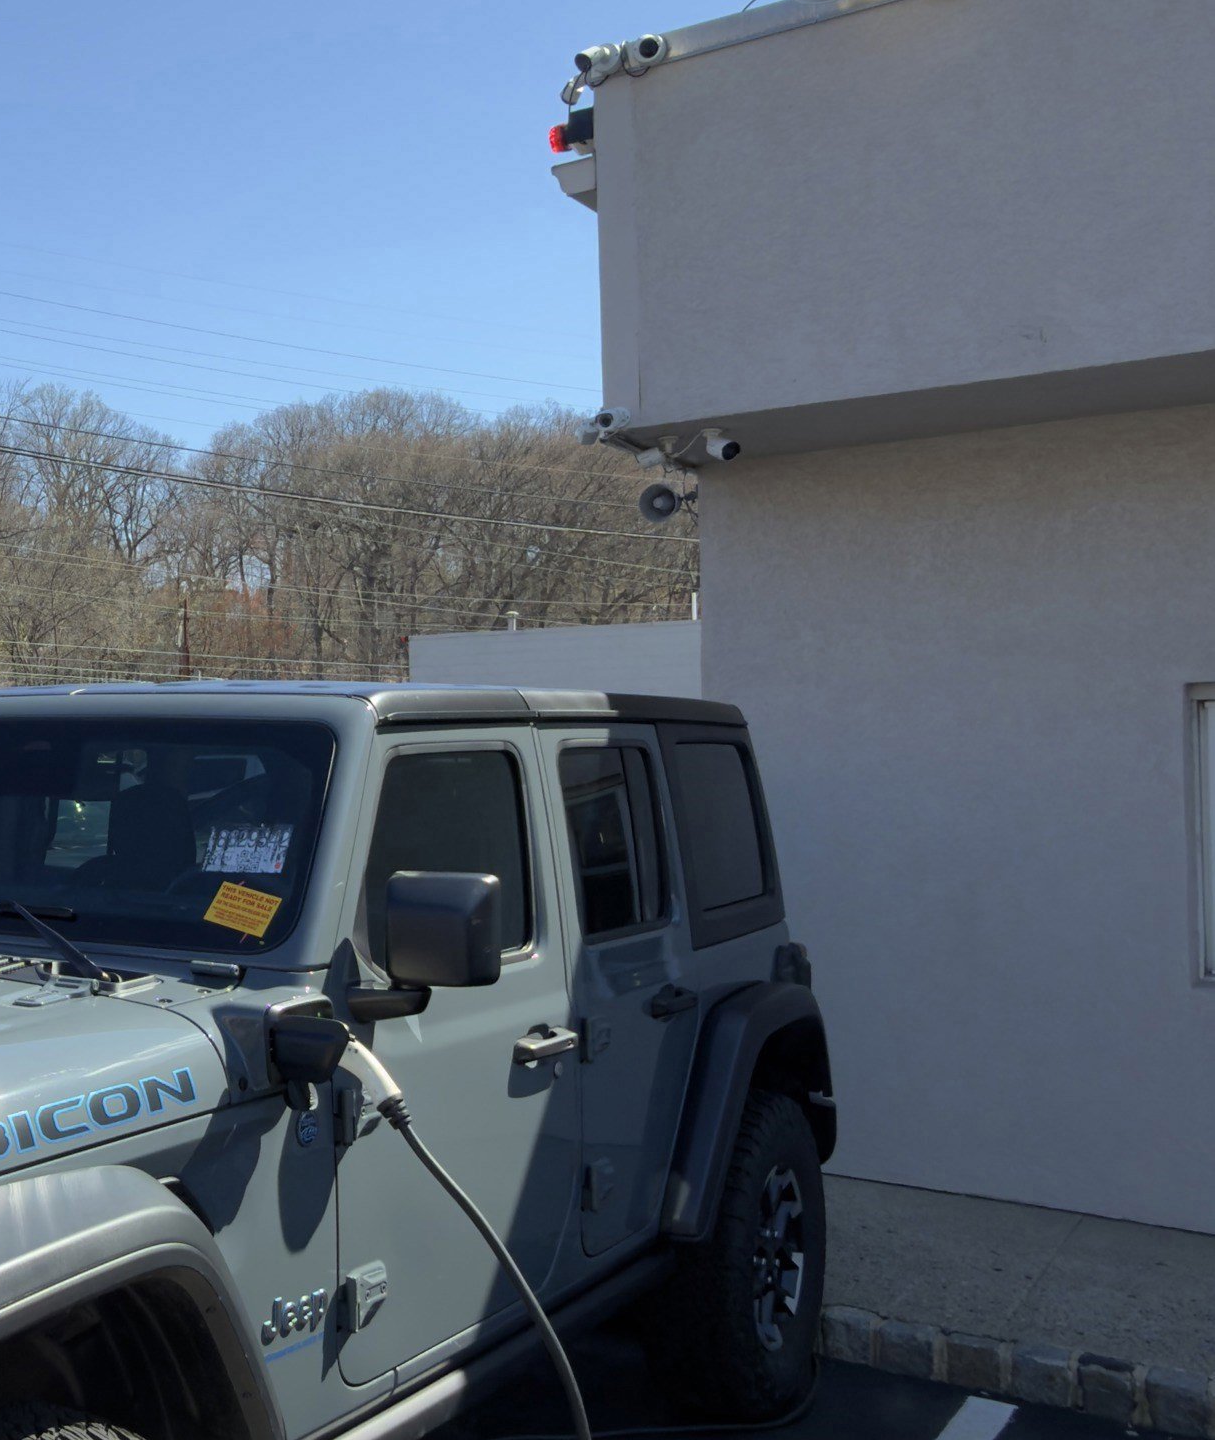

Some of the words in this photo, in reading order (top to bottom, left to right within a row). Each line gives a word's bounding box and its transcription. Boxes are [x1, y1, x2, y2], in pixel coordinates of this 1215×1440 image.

[220, 893, 242, 904] READY
[242, 898, 256, 907] FOR
[256, 902, 273, 913] SALE
[222, 884, 238, 895] THIS
[237, 889, 265, 902] VEHICLE
[264, 897, 280, 906] NOT
[260, 1288, 329, 1347] Jeep
